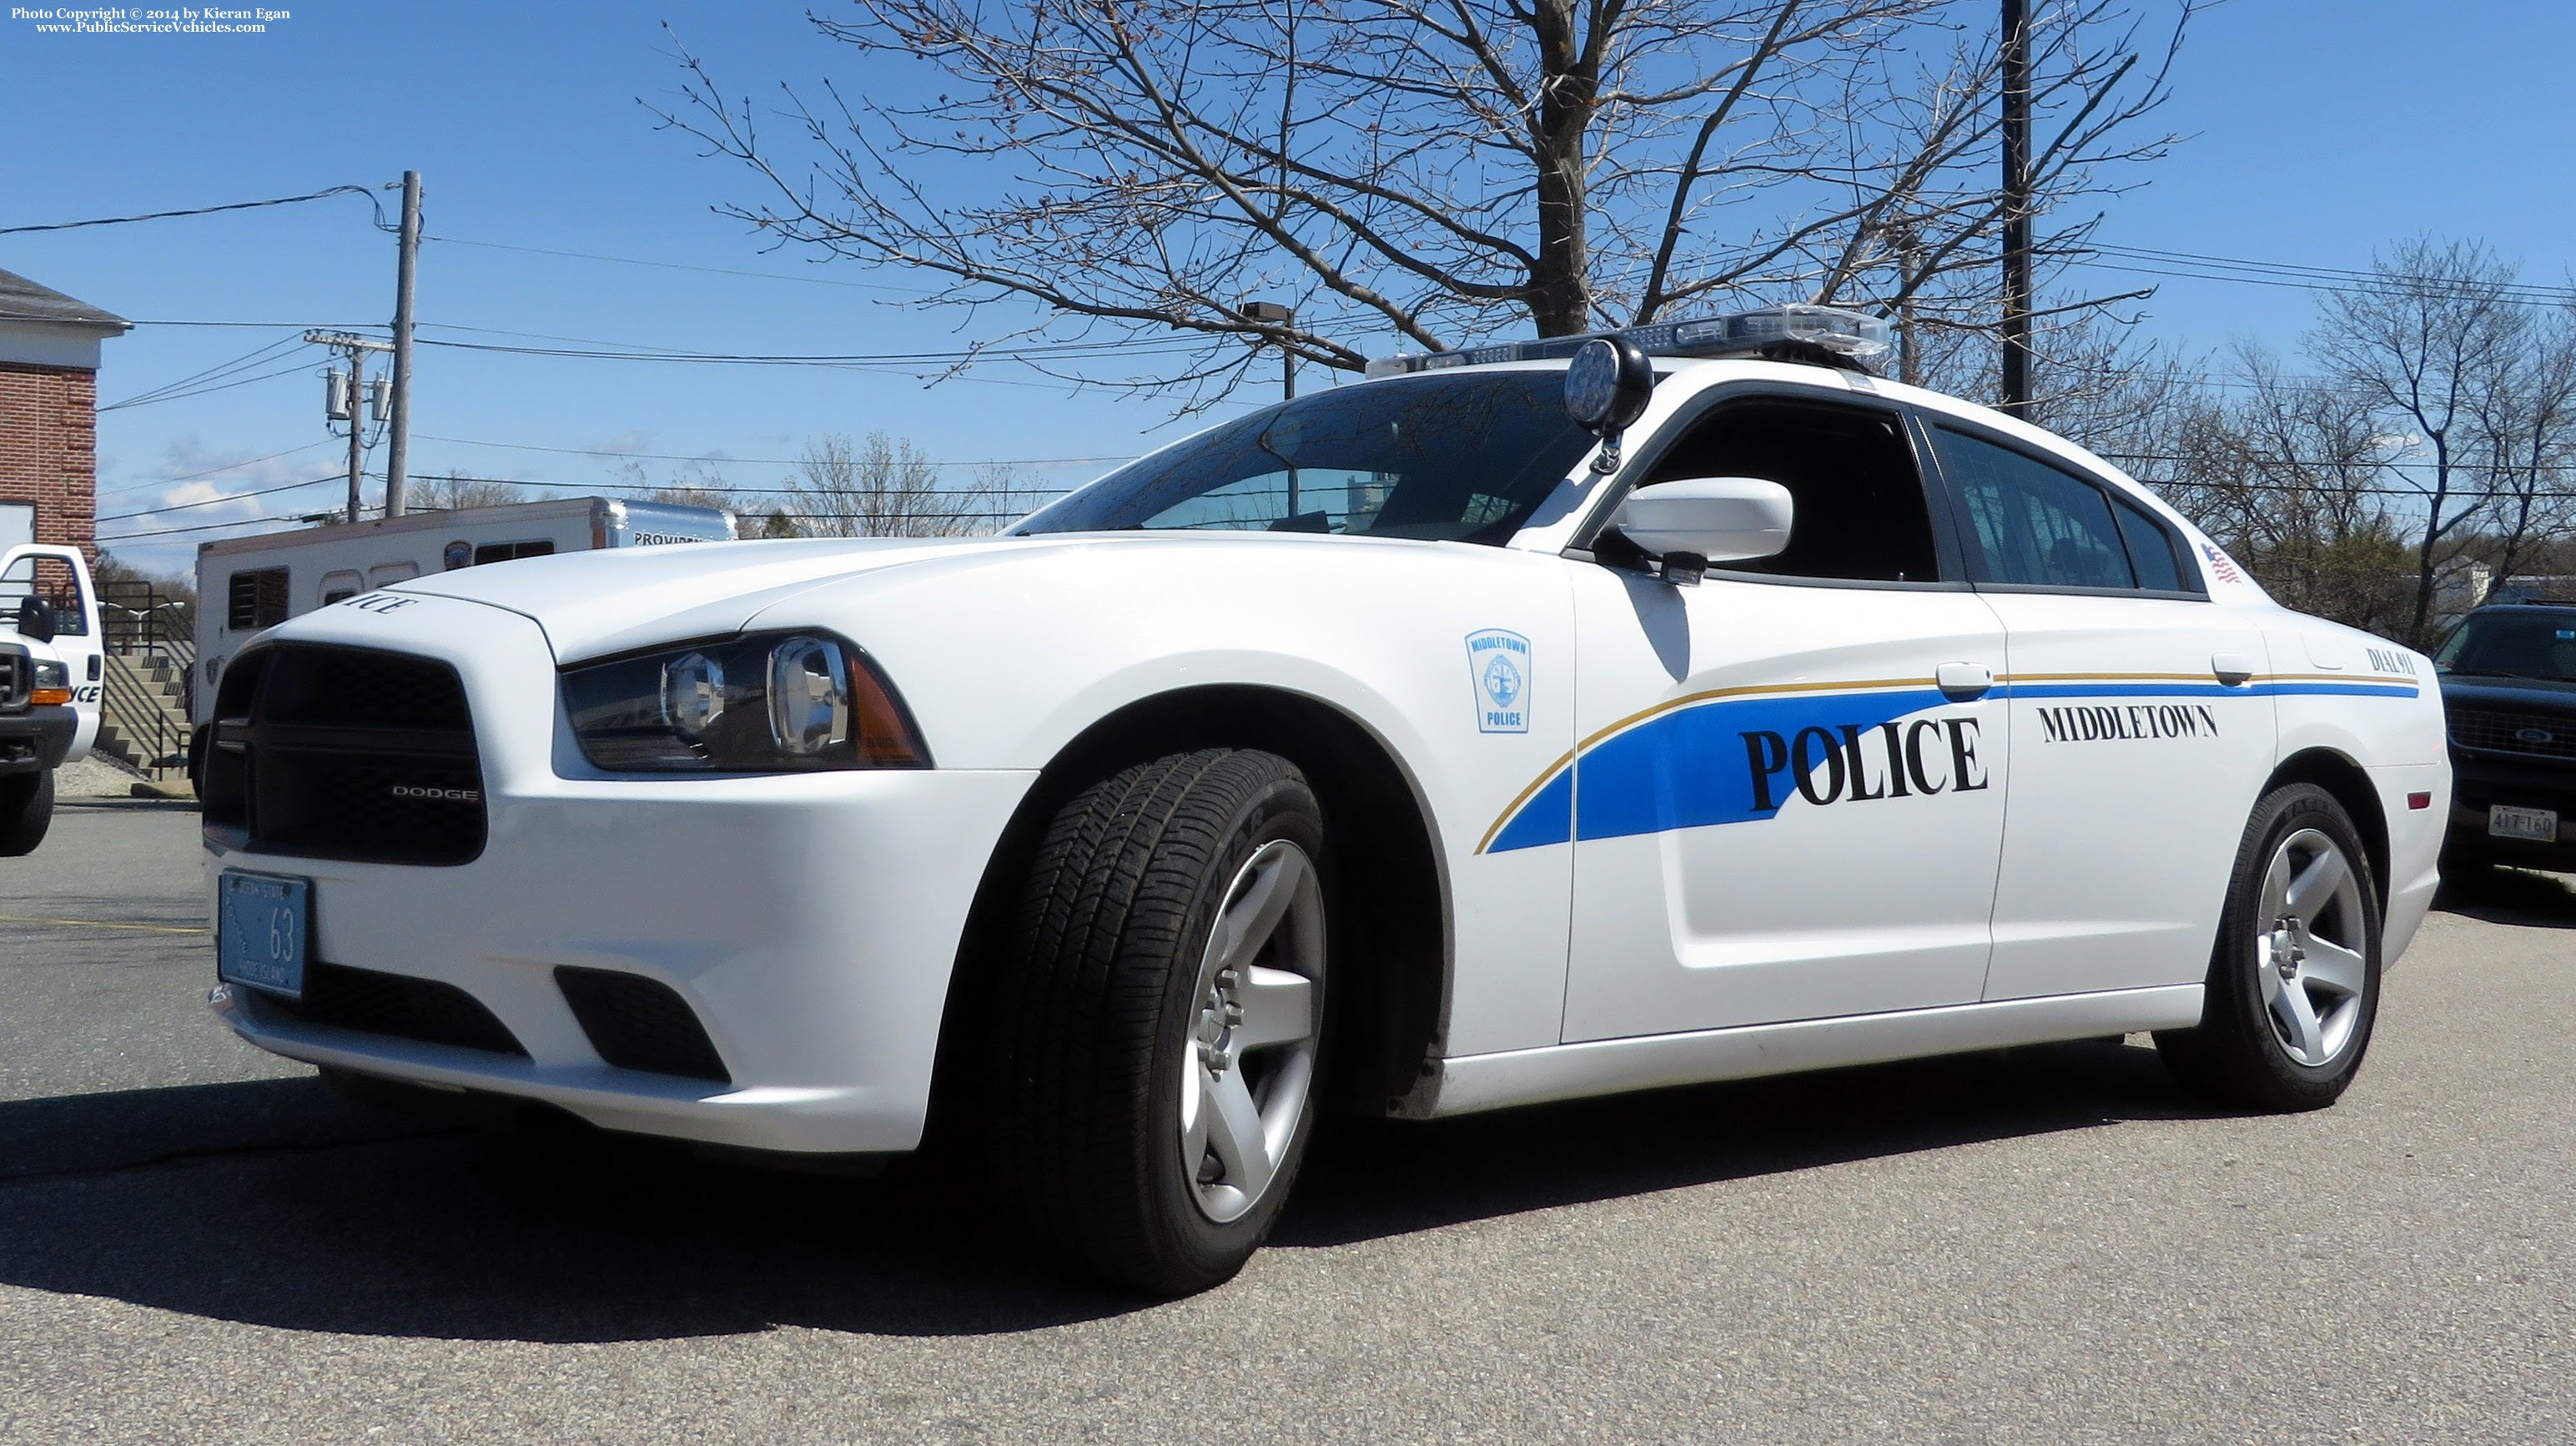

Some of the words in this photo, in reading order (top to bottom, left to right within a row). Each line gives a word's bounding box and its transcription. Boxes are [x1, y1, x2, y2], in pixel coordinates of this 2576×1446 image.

[1471, 636, 1527, 654] MIDDLETOWN
[2365, 647, 2400, 673] DIAL
[2395, 652, 2417, 675] 911
[1487, 712, 1522, 726] POLICE
[2036, 705, 2221, 743] MIDDLETOWN
[1737, 717, 1989, 813] POLICE
[393, 785, 479, 800] DODGE
[270, 907, 294, 962] 63
